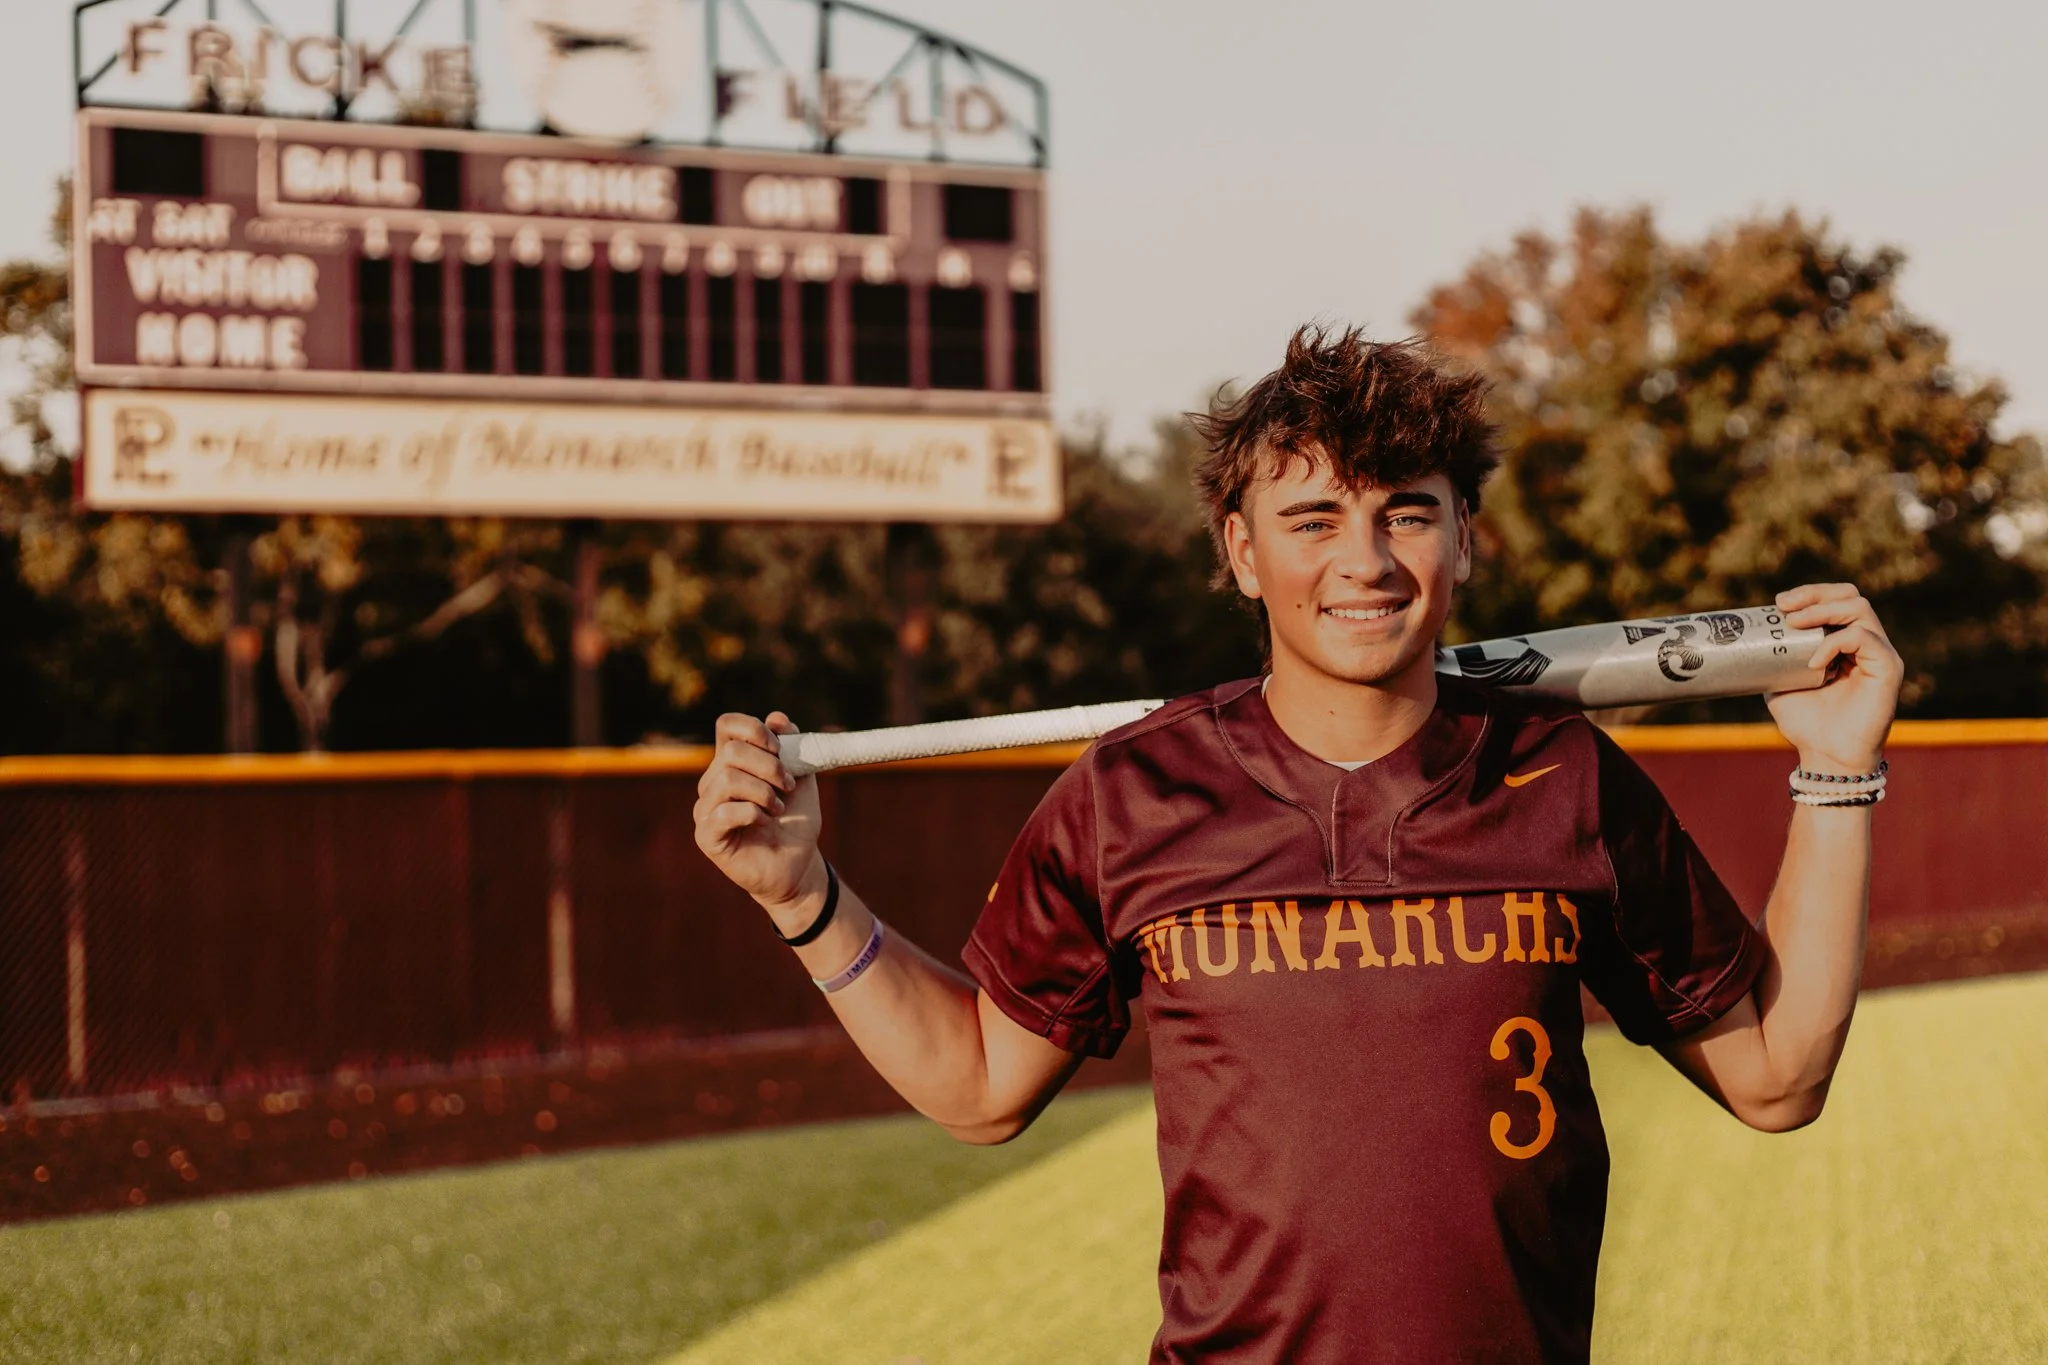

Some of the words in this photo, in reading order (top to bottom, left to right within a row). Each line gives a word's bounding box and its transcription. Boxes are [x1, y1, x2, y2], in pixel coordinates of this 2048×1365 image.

[124, 20, 476, 96] FRICKE
[714, 68, 1005, 136] FIELD
[86, 198, 142, 244] AT
[152, 201, 236, 248] BAT
[281, 144, 421, 207] BALL
[502, 157, 678, 222] STRIKE
[742, 174, 843, 230] OUT
[124, 248, 319, 310] VISITOR
[135, 312, 307, 369] HOME
[400, 410, 462, 500] of
[472, 412, 720, 480] Monarch
[851, 934, 880, 973] MATTER
[1489, 1017, 1557, 1160] 3
